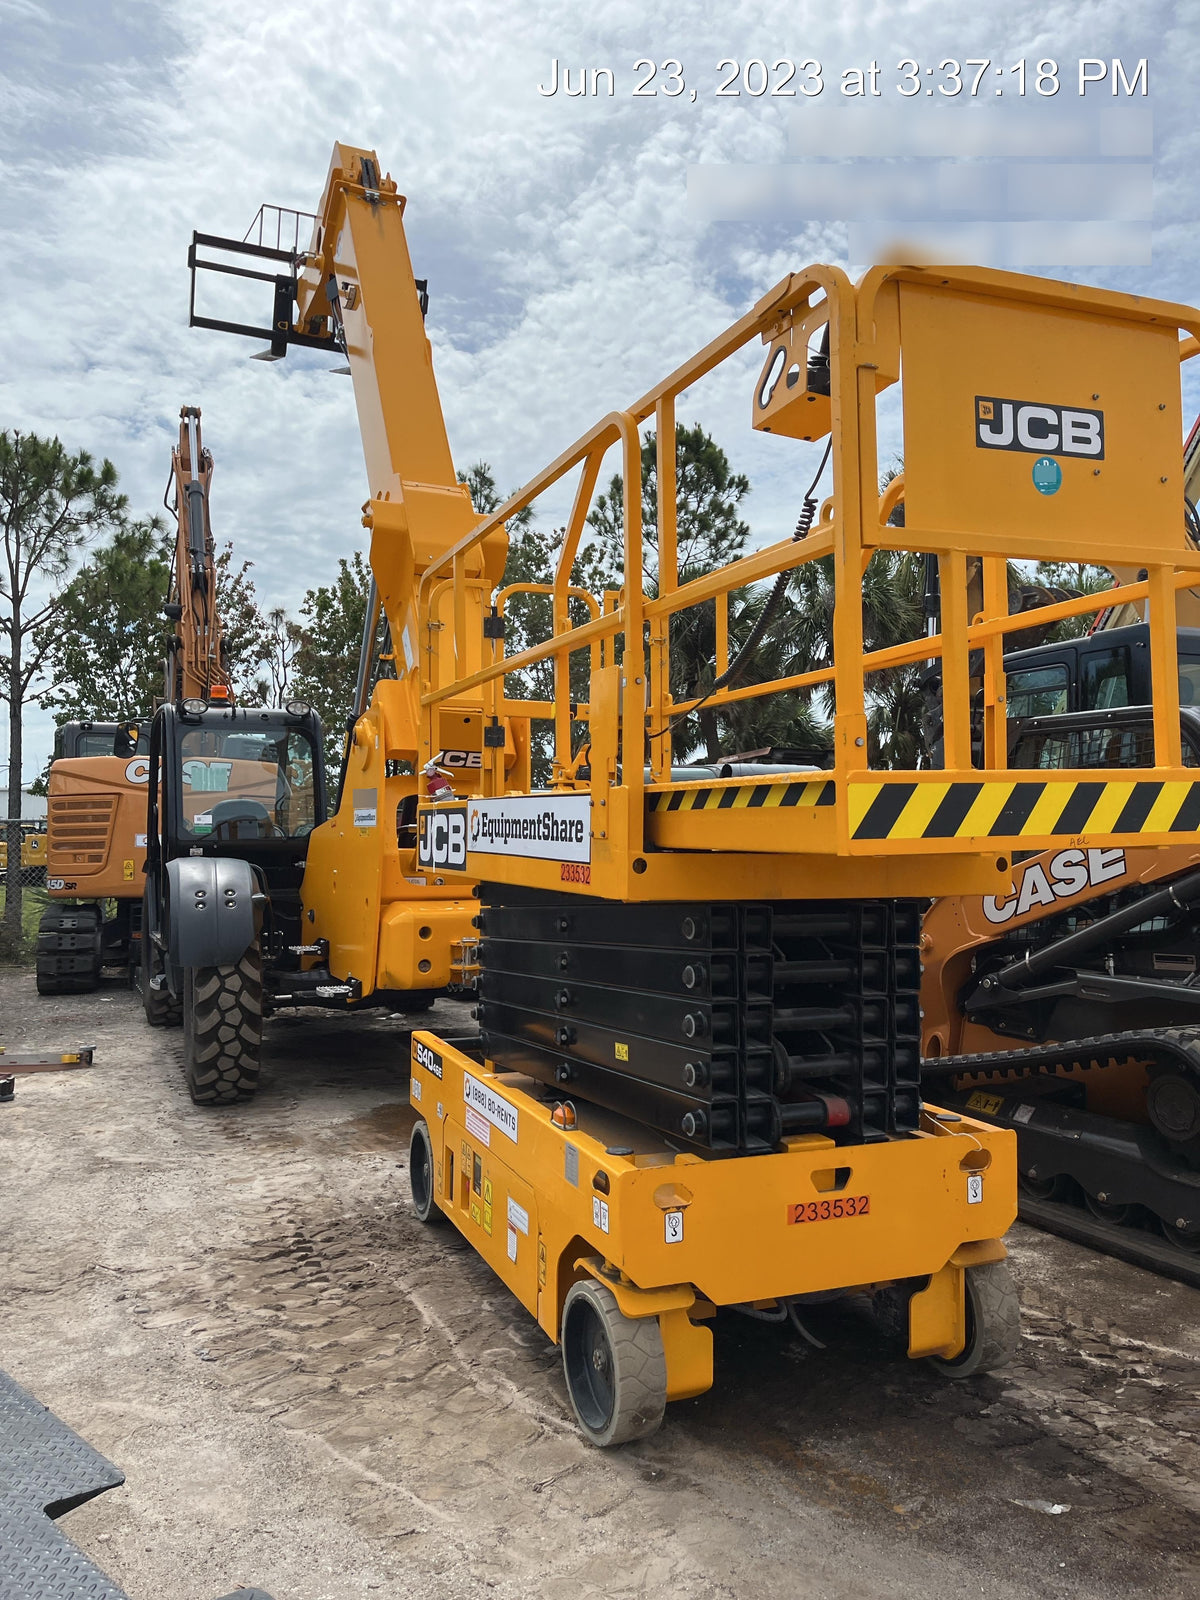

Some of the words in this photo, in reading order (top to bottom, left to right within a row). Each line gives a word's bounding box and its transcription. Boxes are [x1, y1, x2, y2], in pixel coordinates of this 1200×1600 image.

[979, 402, 1102, 455] JCB
[419, 813, 466, 865] JCB
[481, 812, 583, 844] EquipmentShare
[561, 863, 590, 884] 233532
[472, 1085, 487, 1109] (888)
[487, 1097, 516, 1131] 80-RENTS
[794, 1195, 869, 1223] 233532
